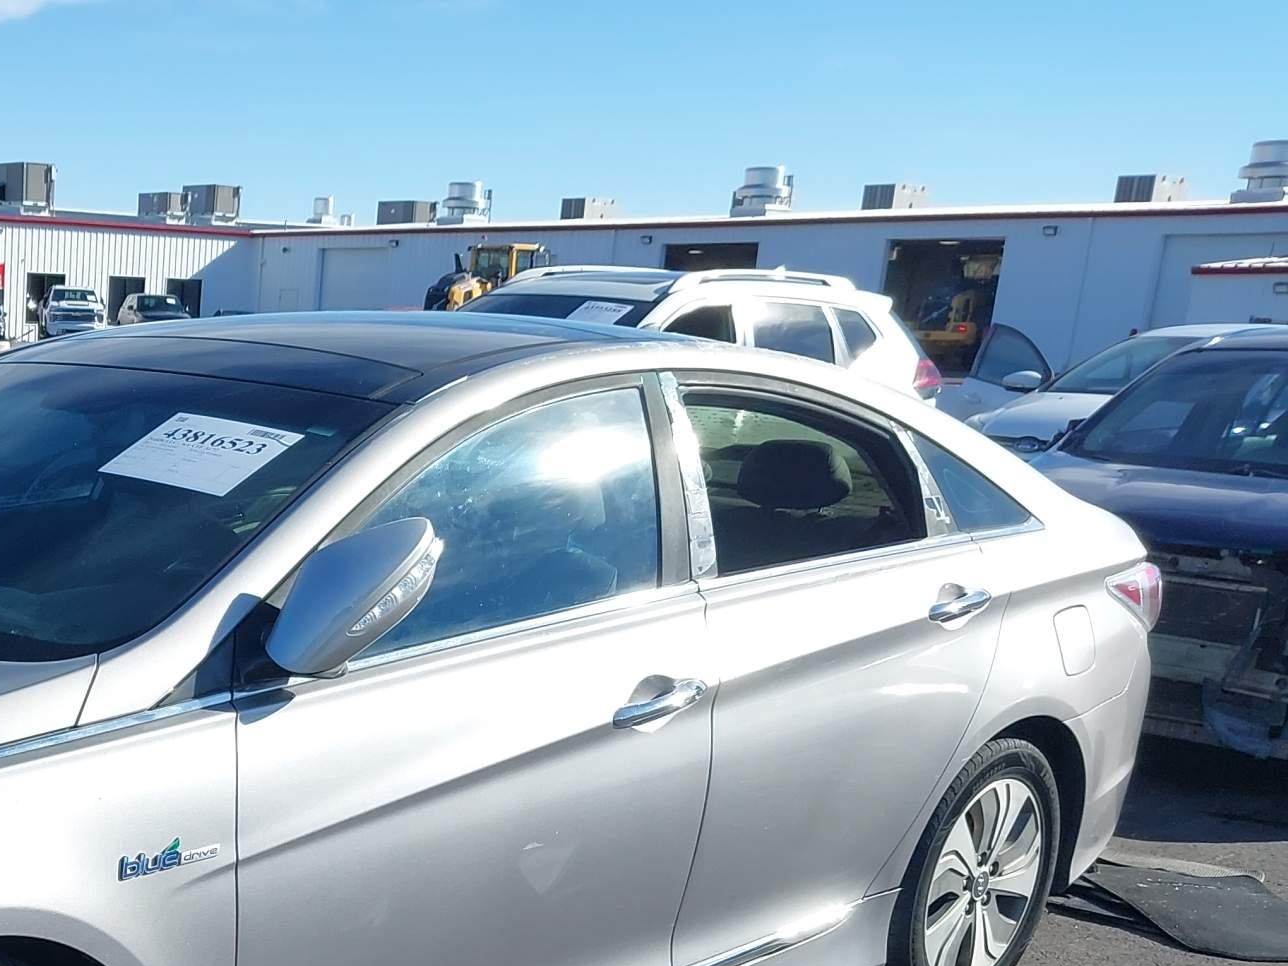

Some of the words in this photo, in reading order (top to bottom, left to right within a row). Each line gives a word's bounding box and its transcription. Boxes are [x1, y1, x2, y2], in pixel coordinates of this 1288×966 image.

[163, 428, 267, 455] 43816523
[118, 849, 182, 881] blue
[183, 847, 218, 861] drive
